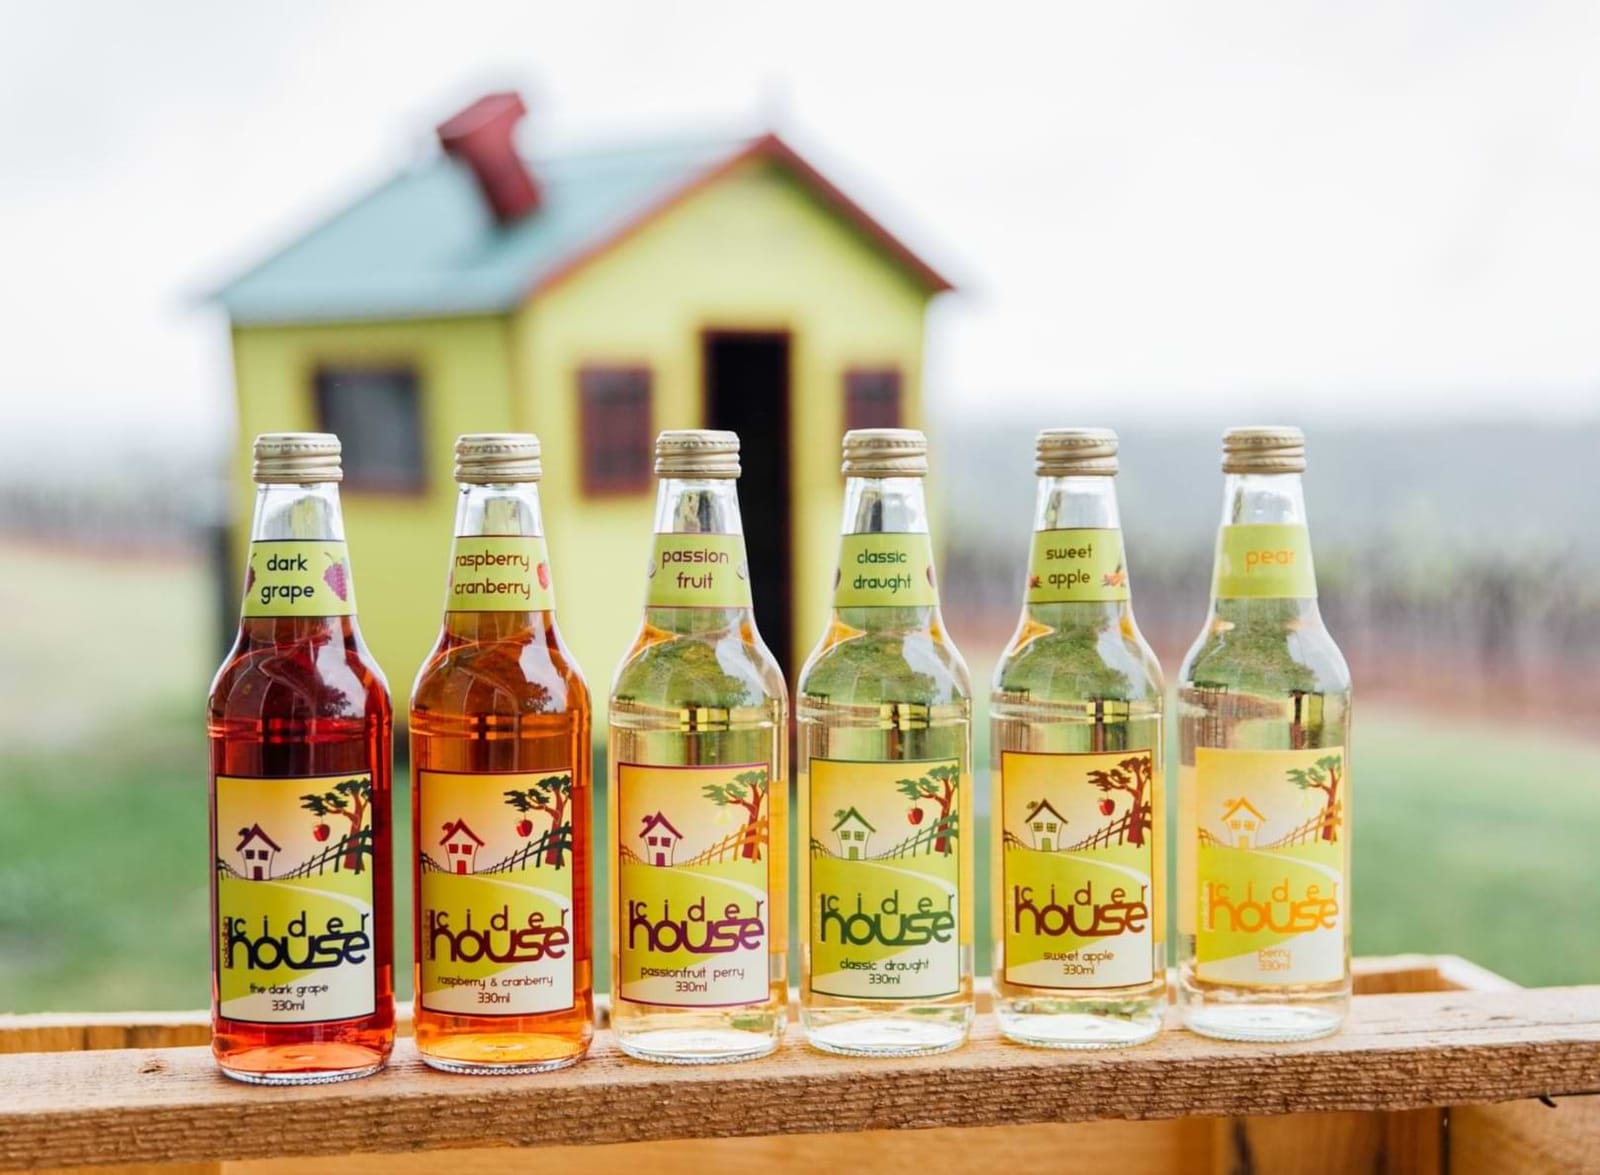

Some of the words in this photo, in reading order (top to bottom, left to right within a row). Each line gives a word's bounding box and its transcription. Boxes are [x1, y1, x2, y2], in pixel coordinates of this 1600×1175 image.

[266, 553, 308, 571] dark
[455, 549, 530, 572] raspberry
[662, 548, 729, 570] passion
[857, 548, 907, 564] classic
[1046, 543, 1092, 560] sweet
[1245, 551, 1295, 573] pear
[455, 577, 531, 600] cranberry
[676, 571, 713, 589] fruit
[853, 574, 912, 594] draught
[1048, 568, 1090, 589] apple
[261, 585, 314, 605] grape
[1020, 880, 1148, 906] cider
[1215, 878, 1338, 903] cider
[635, 896, 764, 922] cider
[826, 889, 955, 915] cider
[1014, 885, 1148, 937] house
[1208, 882, 1339, 933] house
[233, 911, 369, 937] cider
[436, 904, 569, 931] cider
[629, 900, 765, 953] house
[821, 894, 955, 946] house
[228, 916, 370, 970] house
[429, 909, 570, 963] house
[840, 957, 877, 971] classic
[885, 959, 929, 974] draught
[1043, 950, 1079, 961] sweet
[1082, 950, 1115, 965] apple
[640, 966, 707, 979] passionfruit
[713, 968, 744, 982] perry
[869, 973, 901, 985] 330ml
[1063, 964, 1096, 976] 330ml
[250, 982, 266, 993] the
[269, 983, 292, 994] dark
[296, 984, 329, 998] grape
[437, 975, 486, 990] raspberry
[490, 976, 498, 987] &
[502, 976, 553, 990] cranberry
[675, 981, 708, 992] 330ml
[272, 1000, 305, 1011] 330ml
[477, 992, 511, 1004] 330ml
